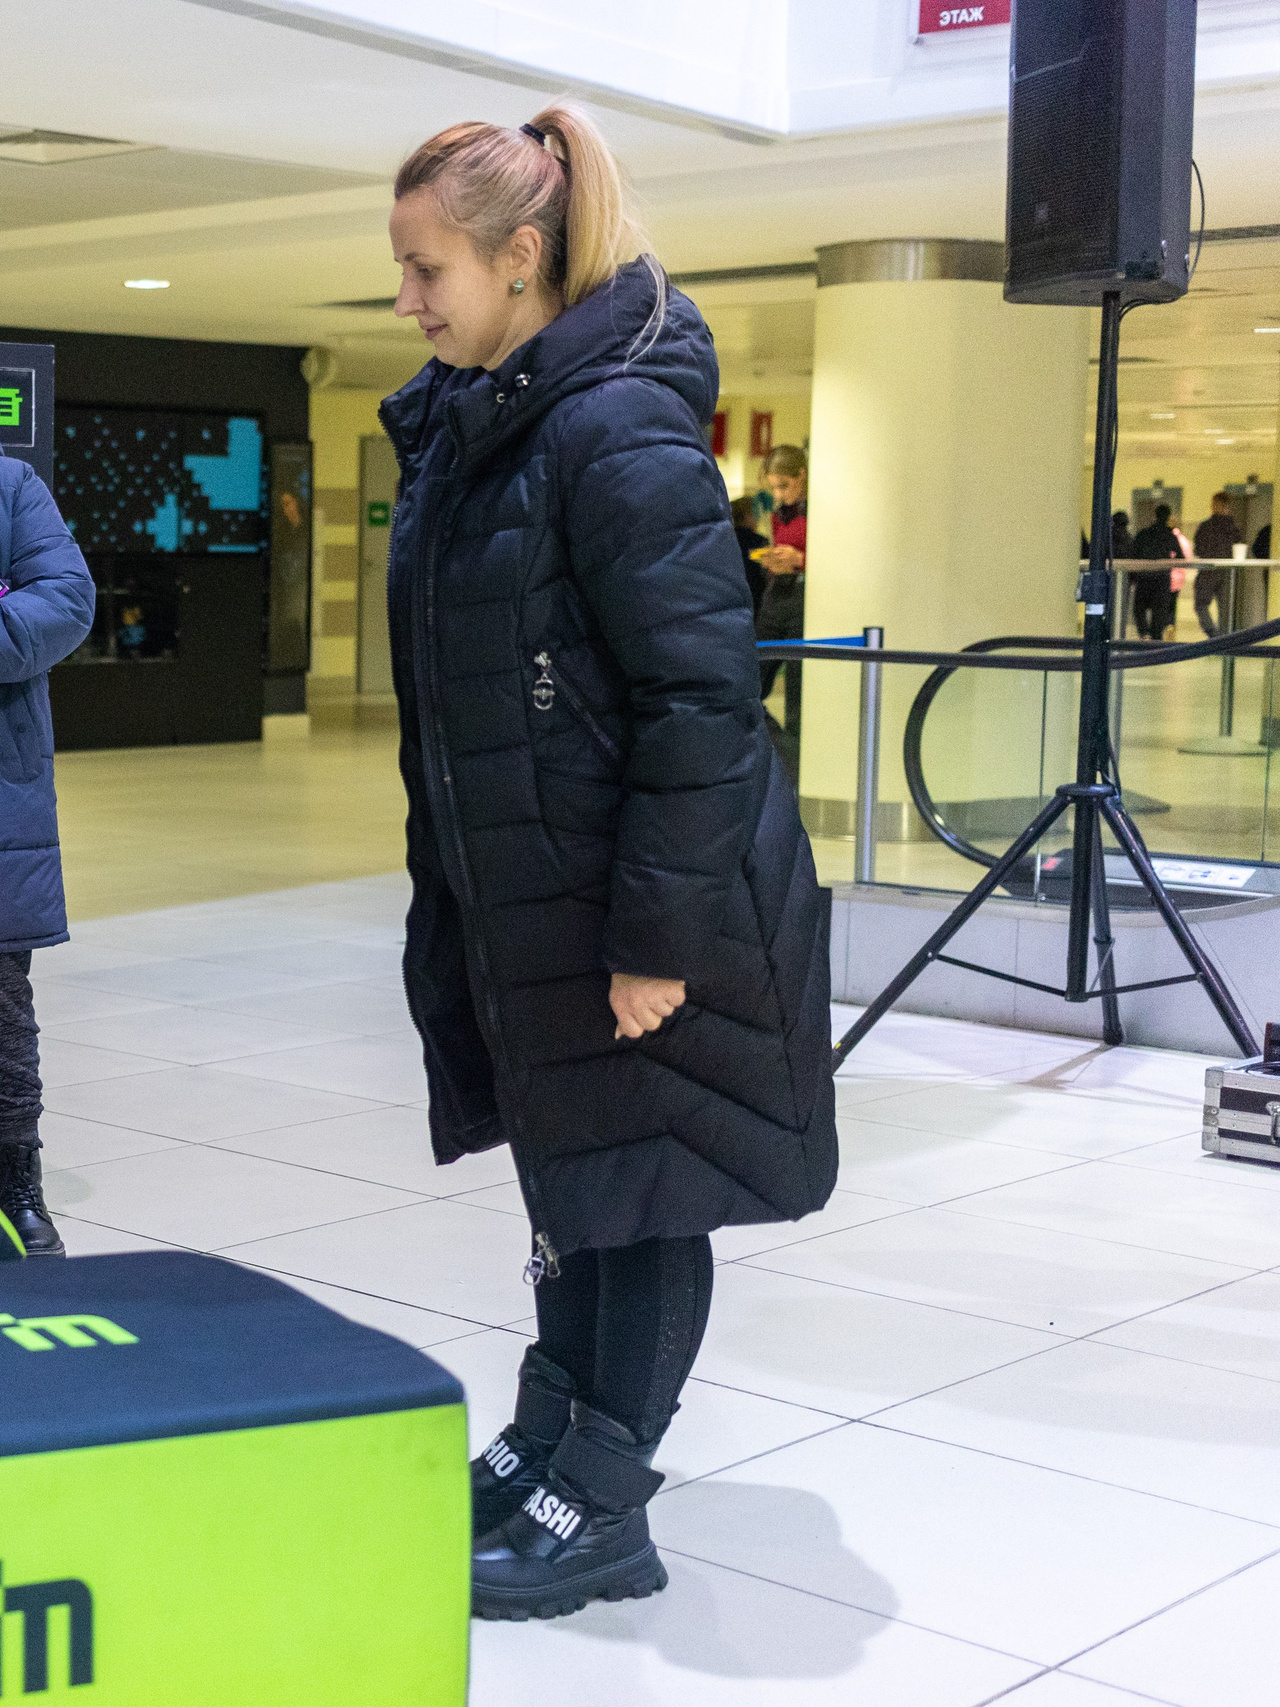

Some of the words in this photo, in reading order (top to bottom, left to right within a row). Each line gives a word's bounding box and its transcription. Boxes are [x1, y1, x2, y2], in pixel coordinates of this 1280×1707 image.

[939, 6, 985, 26] ЭТАЖ
[483, 1435, 522, 1478] HIO
[522, 1485, 581, 1540] ASHI
